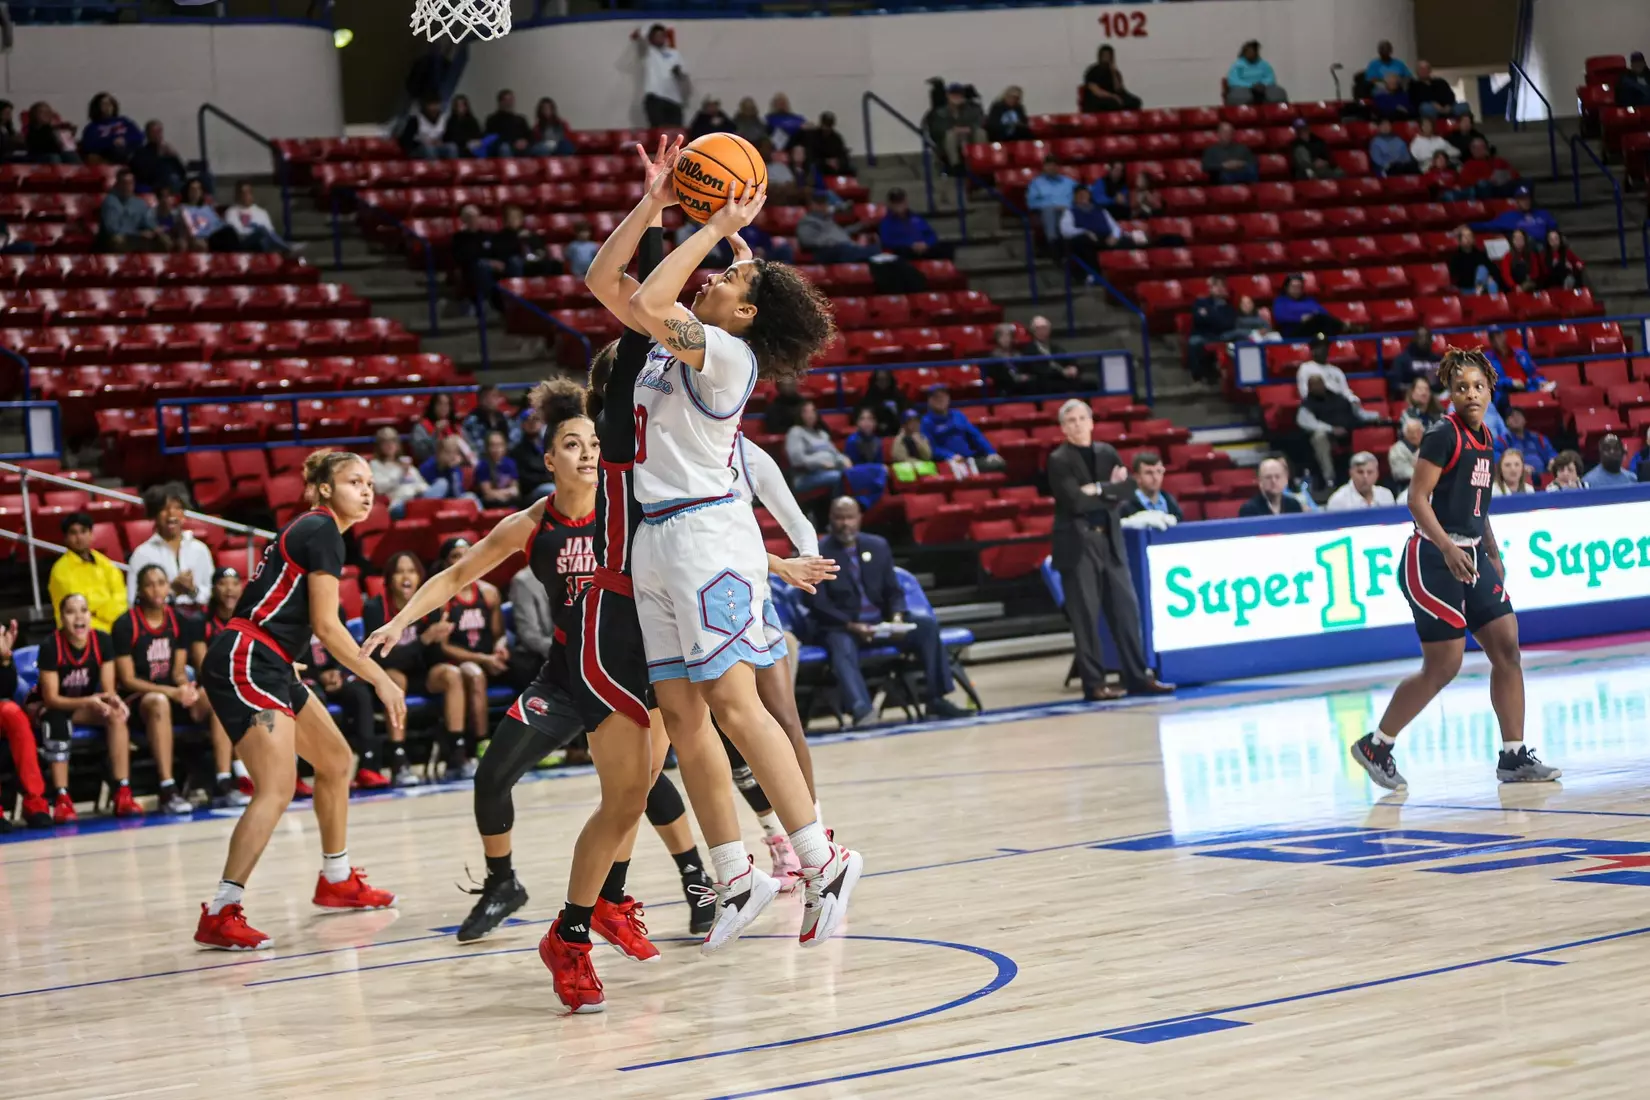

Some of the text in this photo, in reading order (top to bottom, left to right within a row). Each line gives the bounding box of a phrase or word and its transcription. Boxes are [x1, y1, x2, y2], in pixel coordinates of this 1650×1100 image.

[1098, 11, 1148, 38] 102
[677, 155, 724, 191] Wilson
[676, 187, 712, 213] NCAA
[1474, 457, 1490, 472] JAX
[1470, 471, 1491, 488] STATE
[1473, 488, 1482, 517] 1
[560, 536, 595, 556] JAX
[1529, 531, 1650, 587] Super
[1166, 565, 1314, 627] Super
